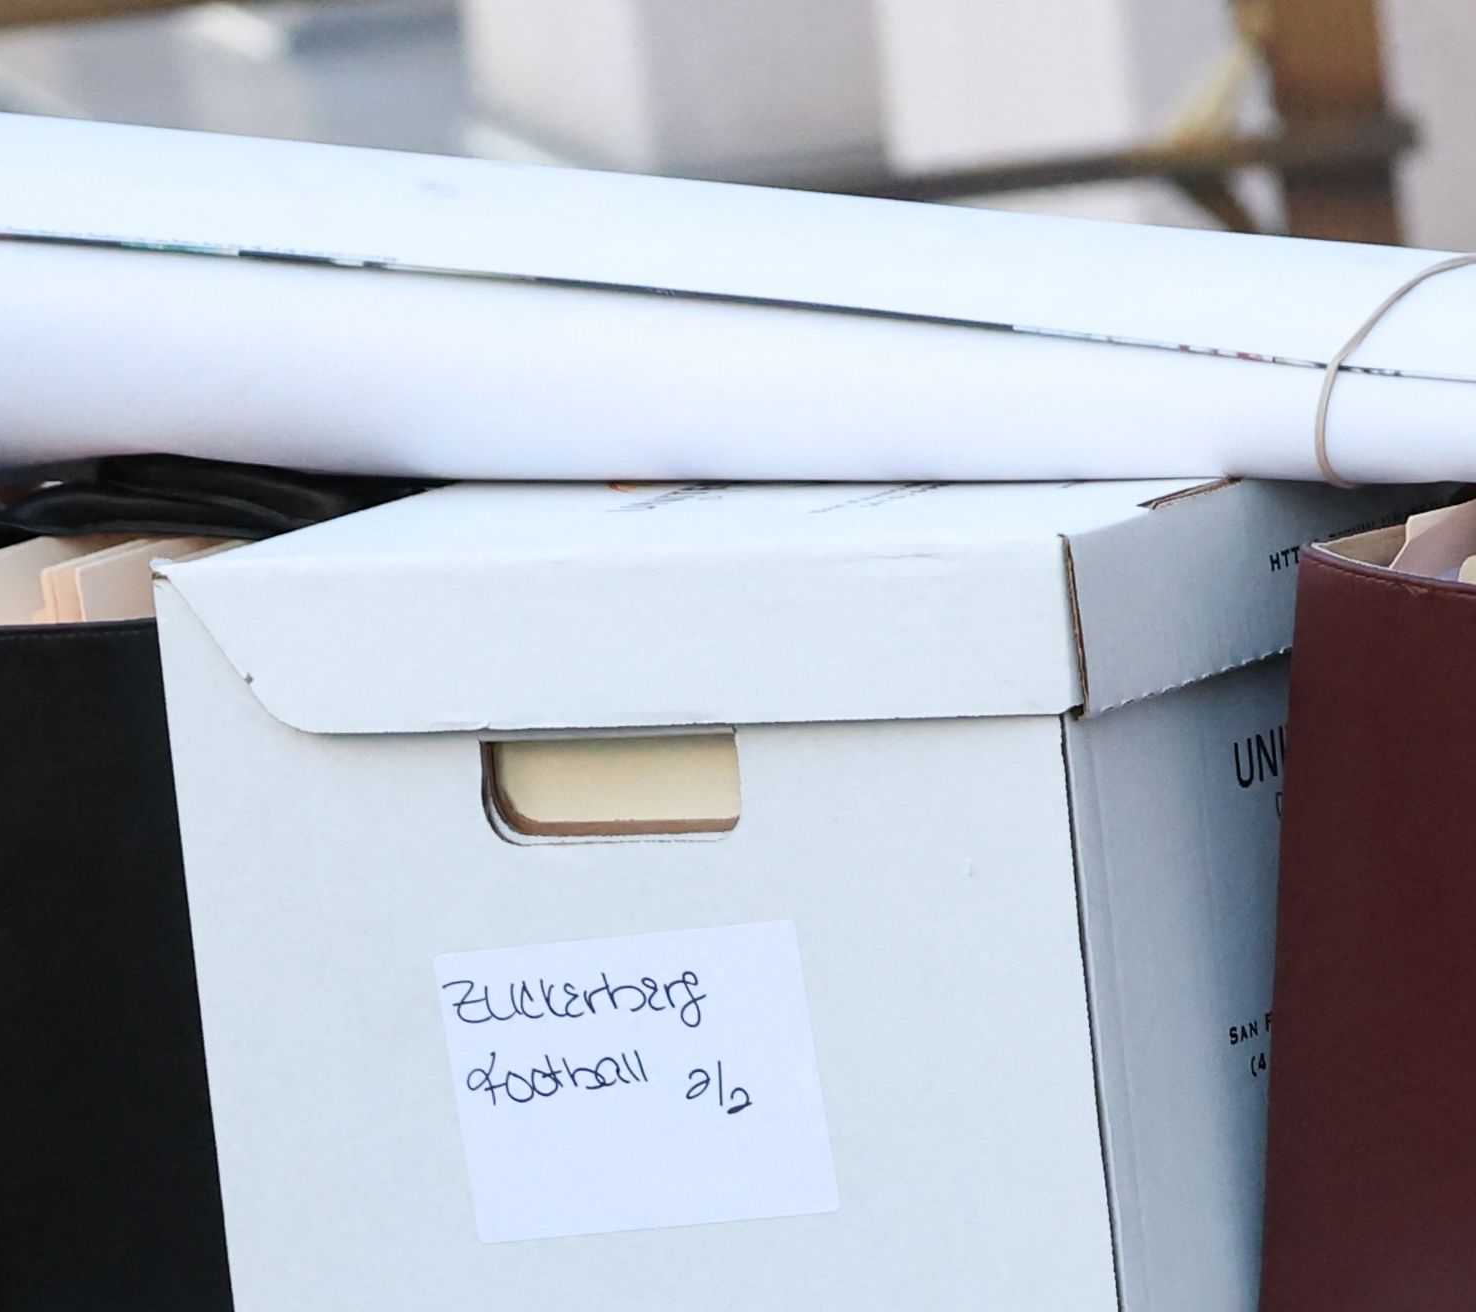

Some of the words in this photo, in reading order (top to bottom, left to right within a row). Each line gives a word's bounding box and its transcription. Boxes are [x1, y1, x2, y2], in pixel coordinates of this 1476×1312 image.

[1233, 726, 1285, 788] UNI
[442, 971, 707, 1027] Zuckerberg
[1229, 1020, 1259, 1045] SAN
[685, 1060, 753, 1114] 2/2
